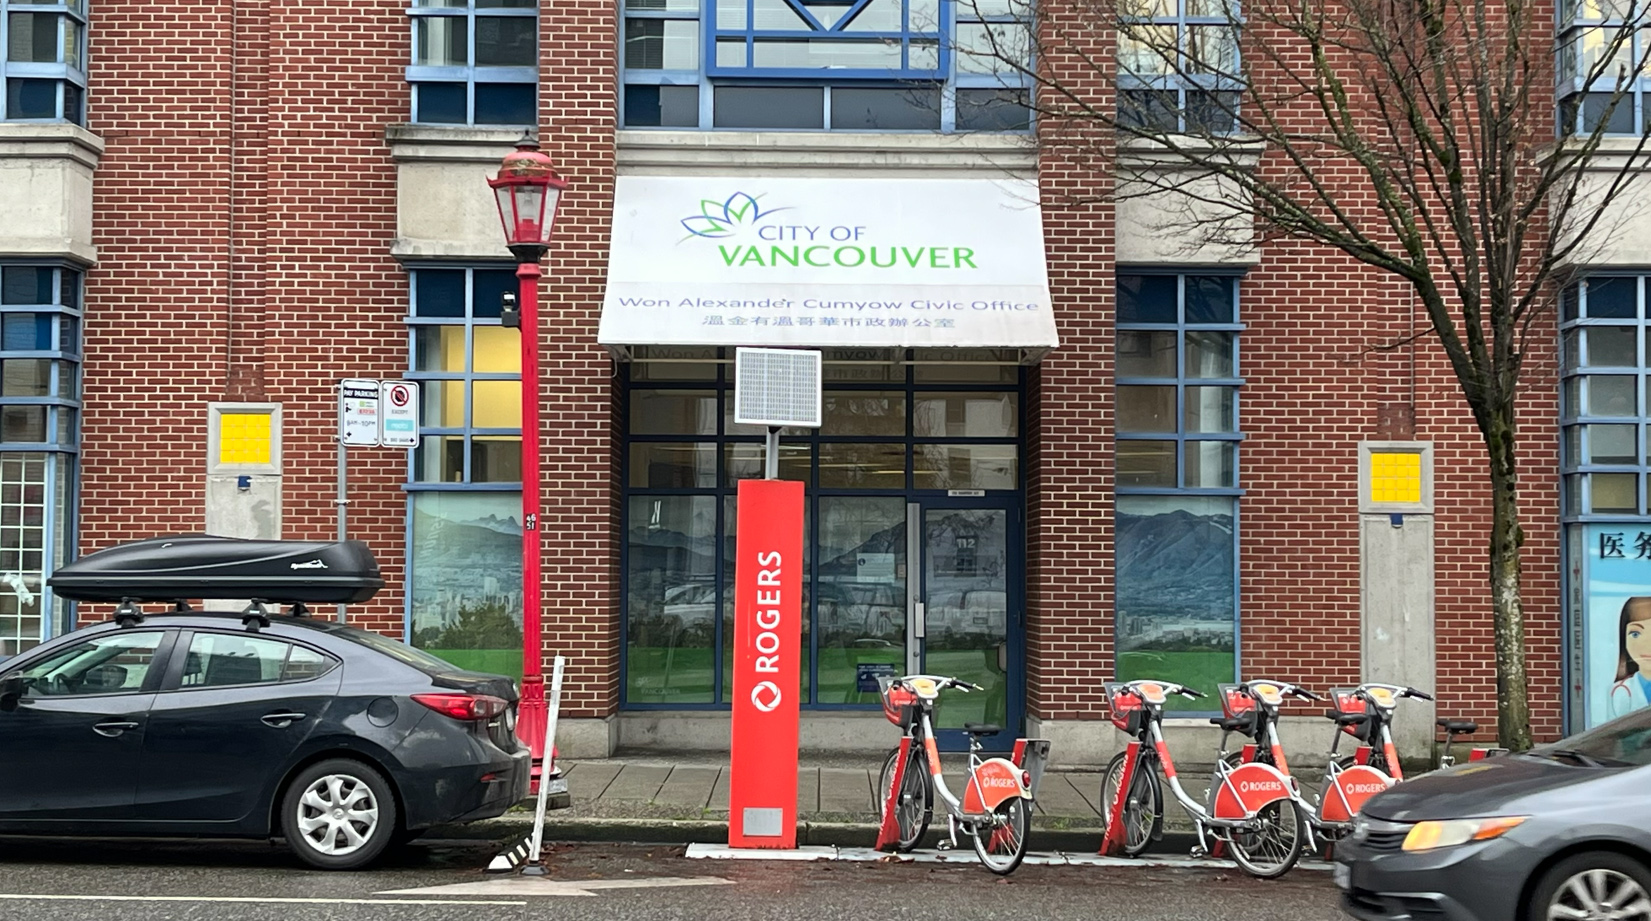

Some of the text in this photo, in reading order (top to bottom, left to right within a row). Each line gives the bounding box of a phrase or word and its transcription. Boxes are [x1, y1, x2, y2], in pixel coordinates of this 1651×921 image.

[758, 225, 867, 241] CITY OF
[718, 245, 978, 269] VANCOUVER
[618, 298, 1039, 311] Won Alexander Cumyow Civic Office
[755, 551, 782, 672] ROGERS
[990, 778, 1015, 787] ROGERS
[1249, 781, 1281, 790] ROGERS
[1355, 783, 1385, 793] ROGERS
